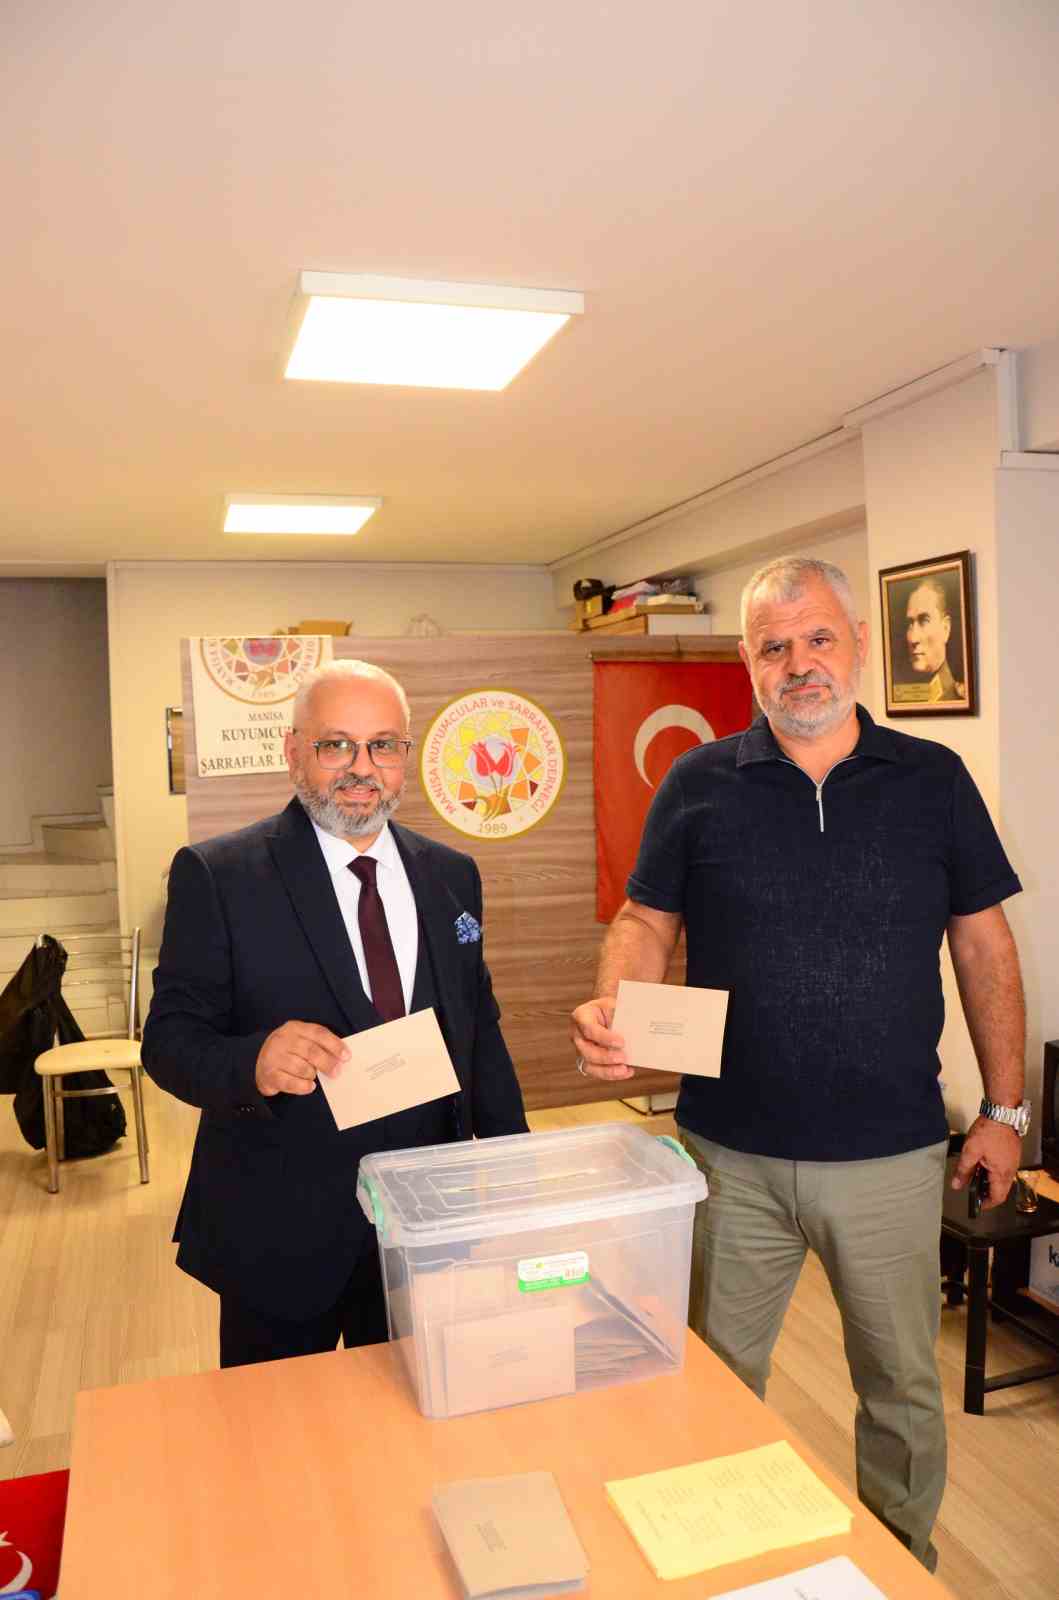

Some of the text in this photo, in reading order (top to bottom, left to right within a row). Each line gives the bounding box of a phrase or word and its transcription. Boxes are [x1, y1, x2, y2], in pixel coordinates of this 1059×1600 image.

[221, 727, 291, 741] KUYUMCU
[429, 697, 488, 763] KUYUMCULAR
[491, 699, 505, 707] ve
[262, 743, 274, 751] ve
[479, 823, 508, 834] 1989
